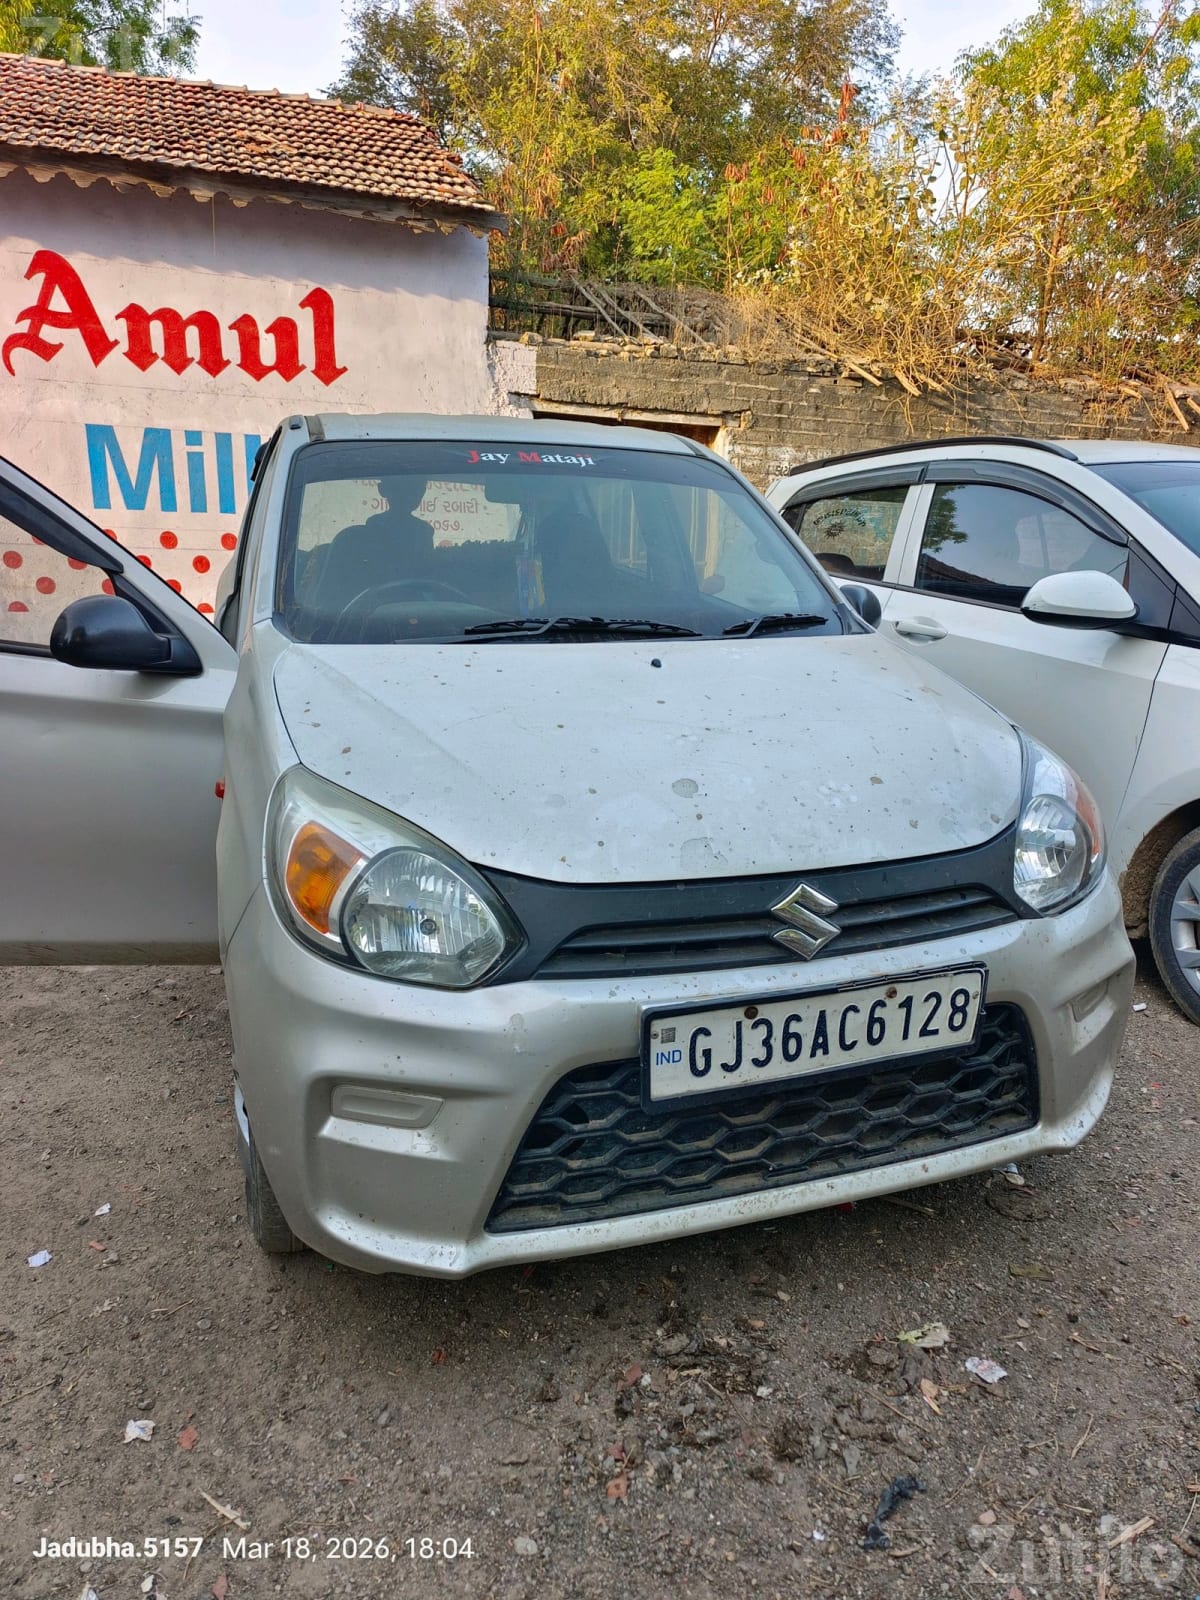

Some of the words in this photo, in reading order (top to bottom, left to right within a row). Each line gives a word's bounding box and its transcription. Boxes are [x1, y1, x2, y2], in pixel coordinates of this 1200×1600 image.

[2, 249, 349, 387] Amul
[467, 450, 511, 464] Jay
[517, 451, 596, 467] Mataji
[442, 497, 480, 514] રબારી
[688, 987, 971, 1078] GJ36AC6128
[655, 1049, 683, 1066] IND
